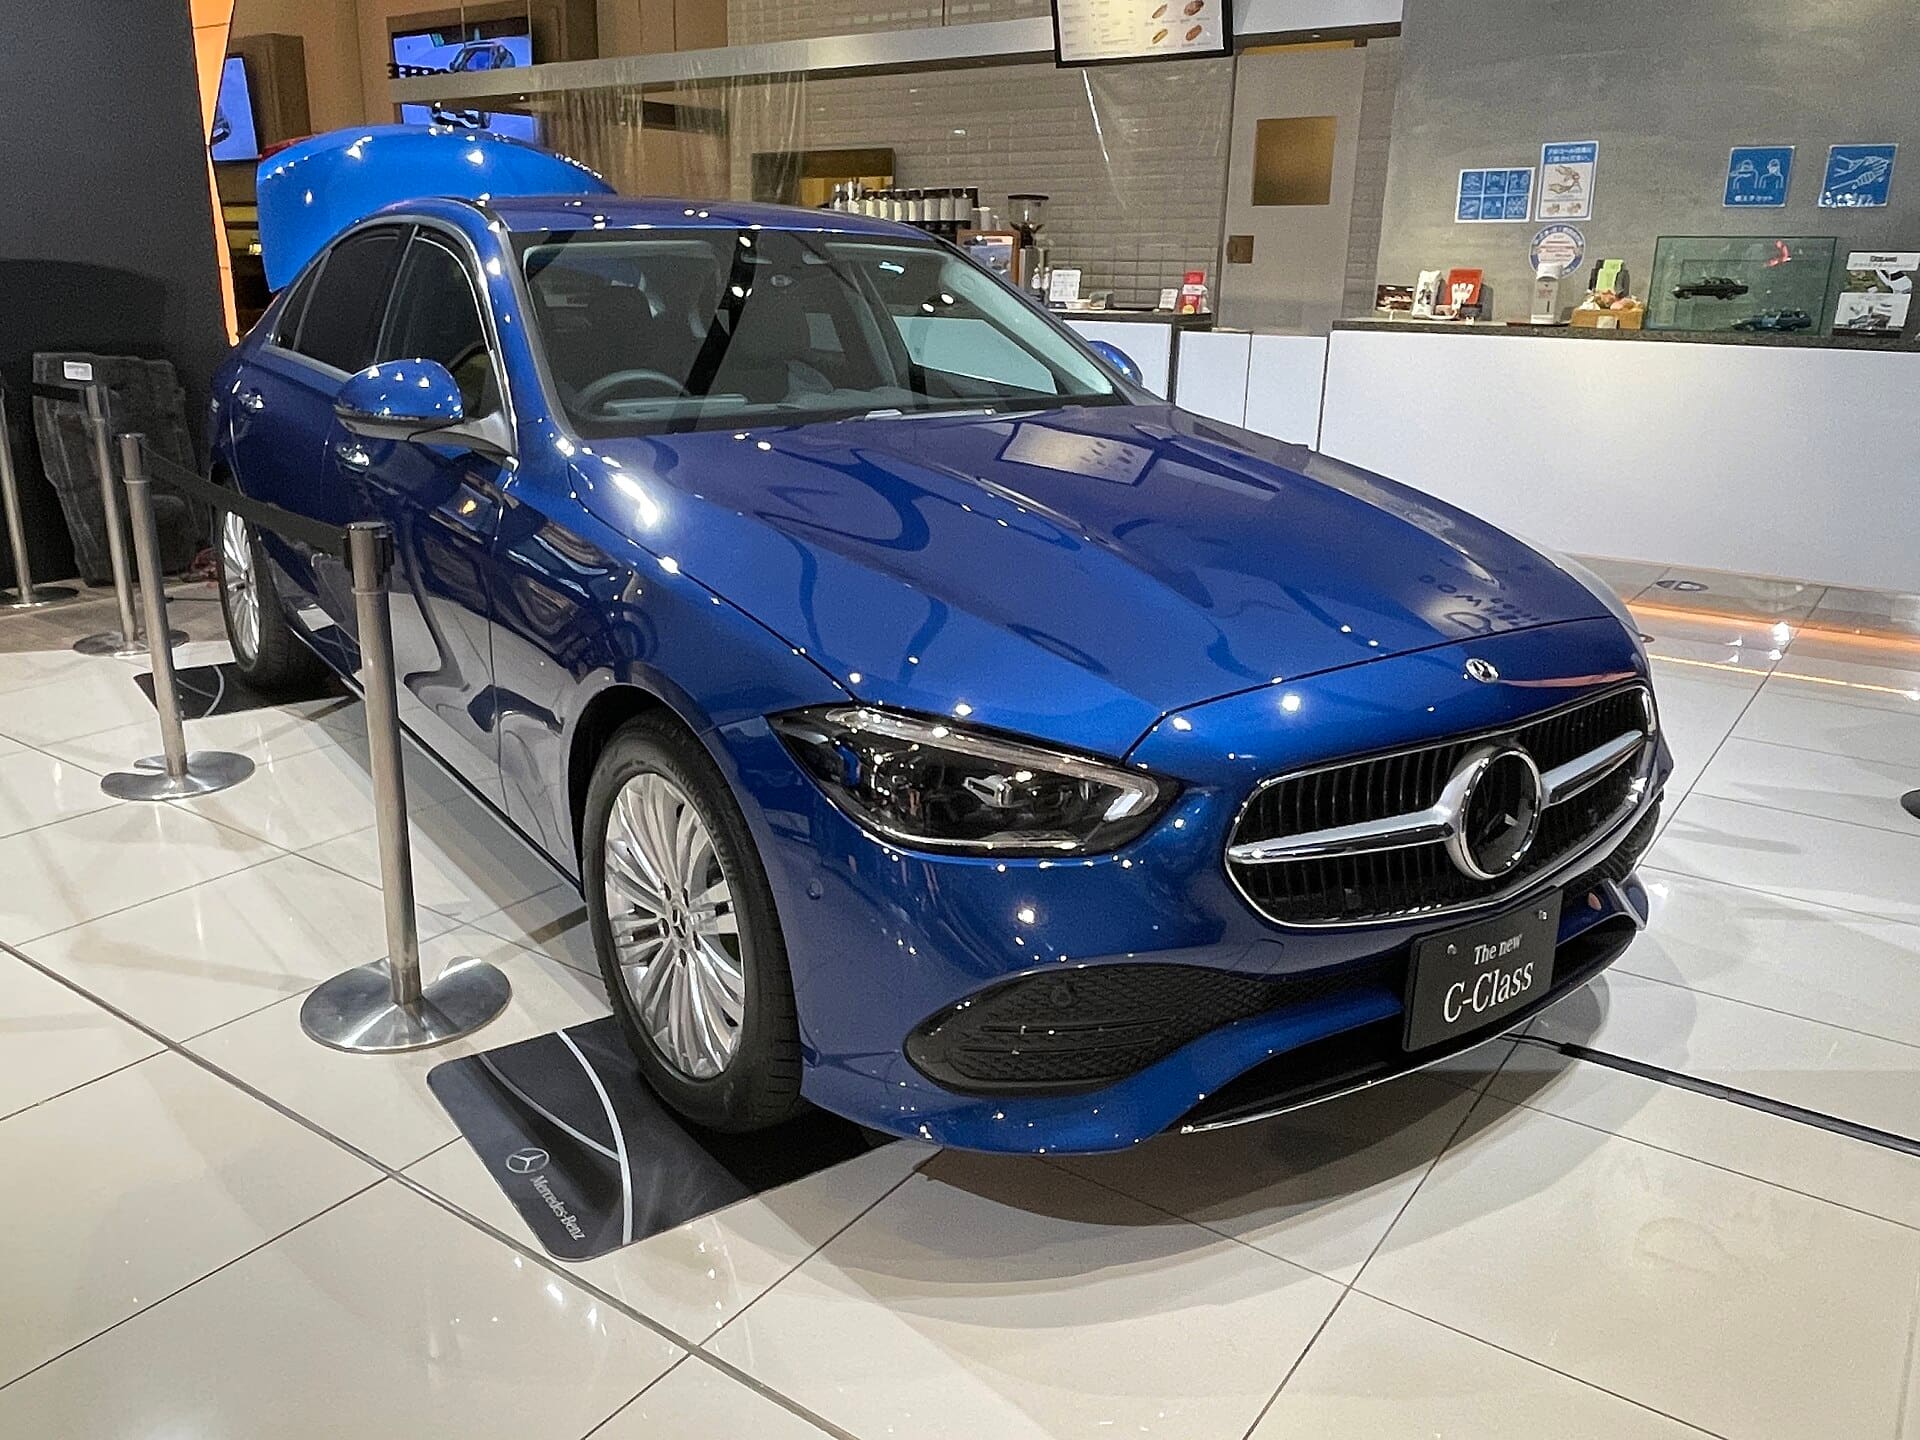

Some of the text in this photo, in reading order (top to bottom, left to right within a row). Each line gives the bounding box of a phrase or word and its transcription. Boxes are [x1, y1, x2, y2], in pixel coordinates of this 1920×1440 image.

[1474, 933, 1523, 965] The new
[1443, 961, 1534, 1023] C-Class
[530, 1175, 586, 1241] Mercedes-Benz
